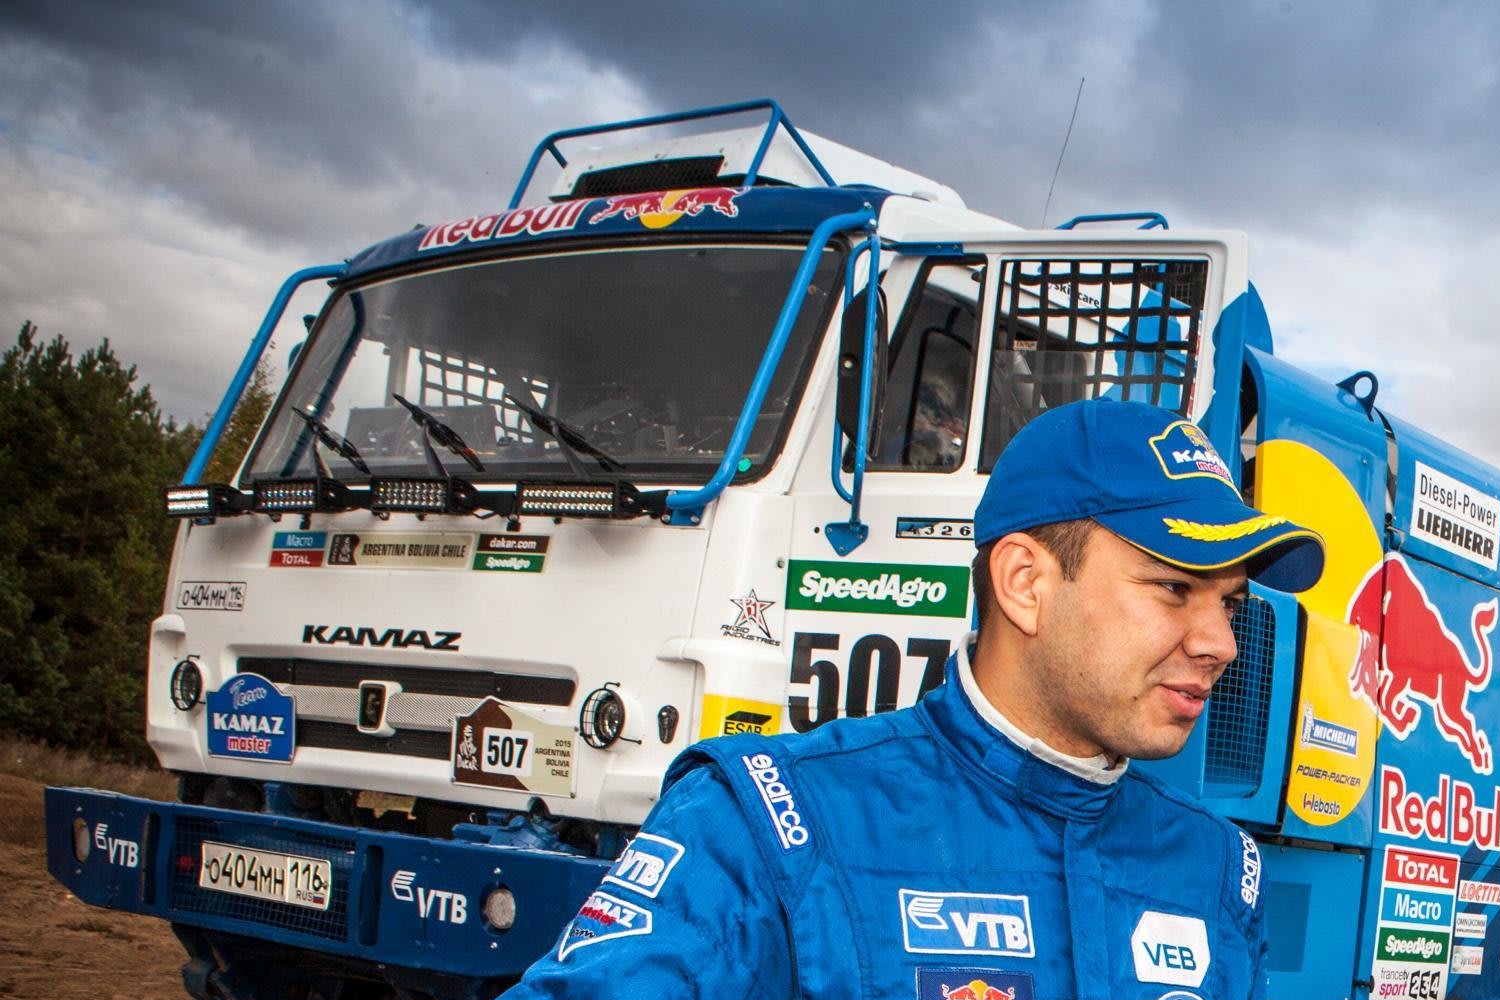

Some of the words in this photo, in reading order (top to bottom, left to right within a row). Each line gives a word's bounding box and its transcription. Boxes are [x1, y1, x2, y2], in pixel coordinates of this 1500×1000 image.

[1420, 473, 1497, 528] Diesel-Power
[285, 534, 313, 548] Macro
[489, 536, 537, 550] dakar.com
[1417, 507, 1495, 561] LIEBHERR
[361, 543, 405, 556] ARGENTINA
[407, 544, 441, 557] BOLIVIA
[441, 543, 467, 558] CHILE
[485, 556, 530, 571] SpeedAgro
[799, 570, 947, 608] SpeedAgro
[302, 624, 462, 652] KAMAZ
[721, 624, 750, 634] RIGID
[723, 630, 781, 647] INDUSTRIES
[230, 679, 268, 710] Team
[788, 631, 951, 733] 507
[213, 712, 285, 735] KAMAZ
[1313, 725, 1357, 747] MICHELIN
[227, 734, 271, 754] master
[486, 734, 529, 769] 507
[534, 747, 571, 758] ARGENTINA
[554, 739, 572, 748] 2015
[545, 759, 570, 768] BOLIVIA
[551, 769, 569, 778] CHILE
[1296, 764, 1361, 787] POWER-PACKER
[742, 754, 809, 850] sparco
[1303, 793, 1341, 816] Webasto
[1379, 764, 1450, 844] Red
[107, 837, 139, 868] VTB
[289, 861, 323, 891] 116
[616, 849, 665, 887] VTB
[1394, 854, 1449, 884] TOTAL
[296, 889, 313, 902] RUS
[417, 887, 467, 924] VTB
[1394, 893, 1441, 921] Macro
[949, 911, 1029, 950] VTB
[1142, 941, 1197, 971] VEB
[1385, 934, 1442, 959] SpeedAgro
[1379, 981, 1407, 999] sport
